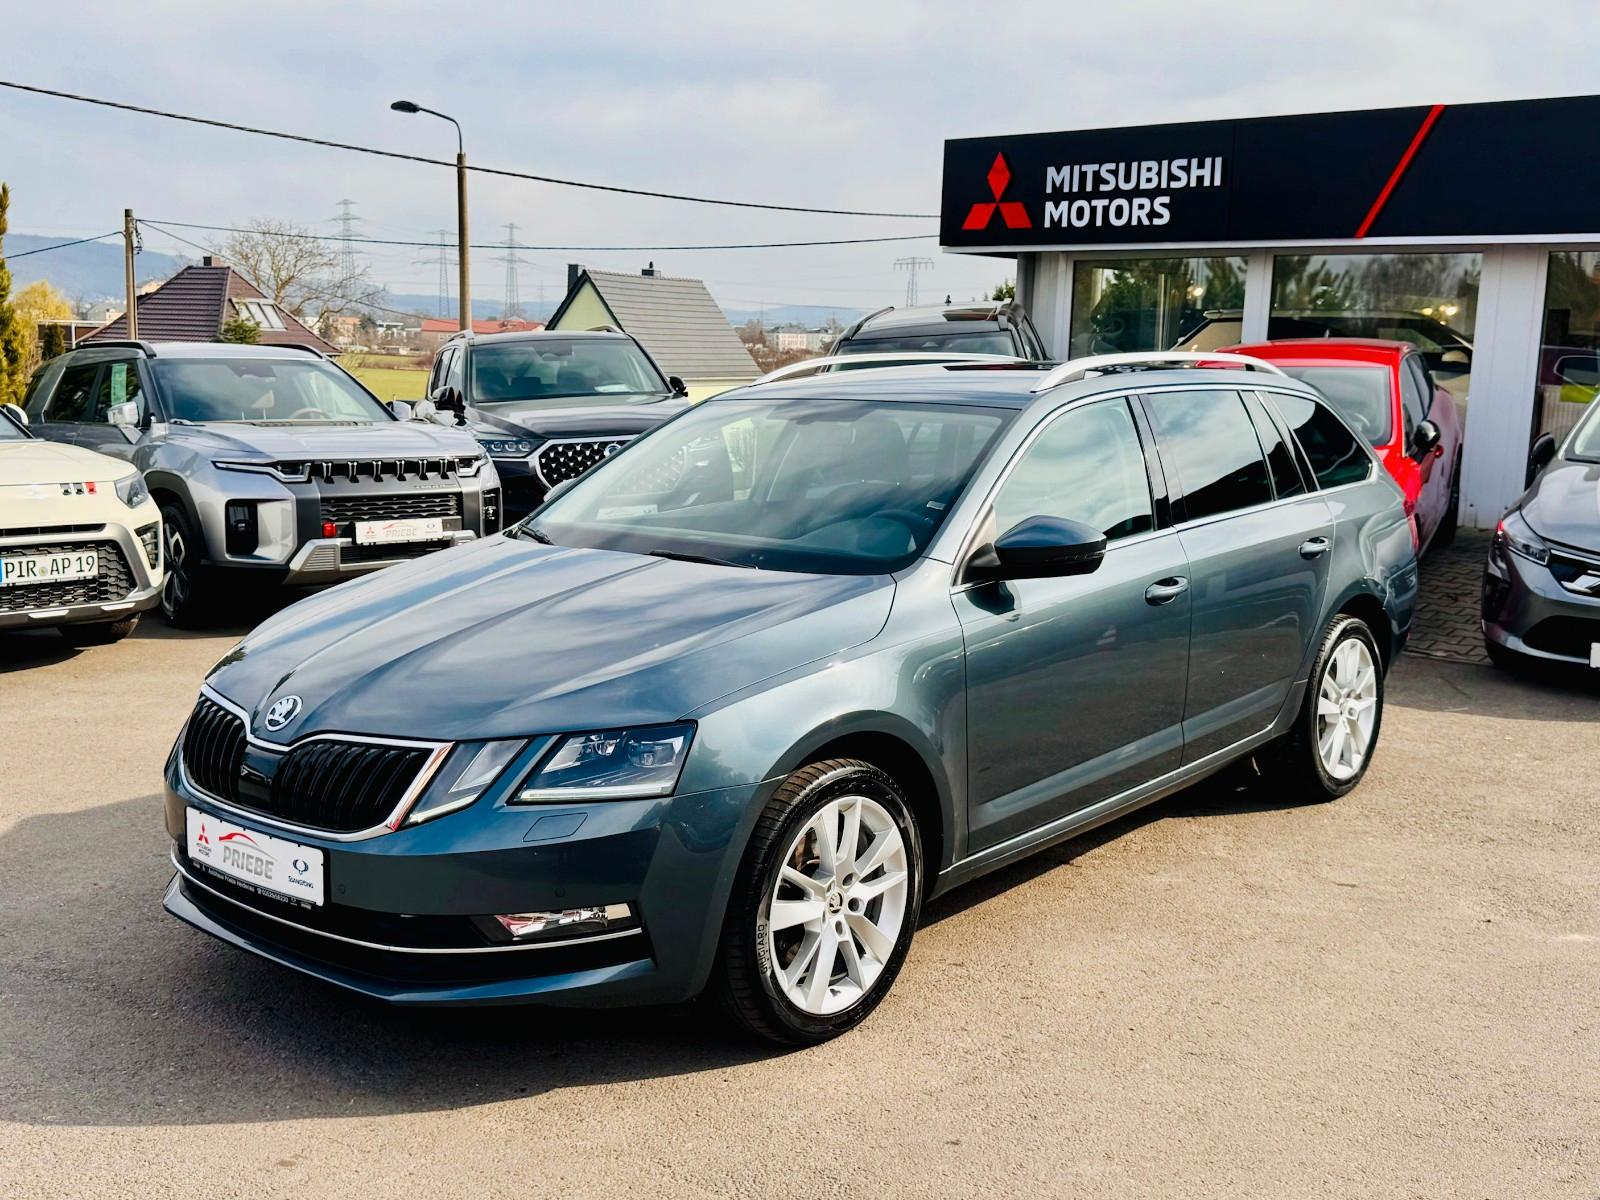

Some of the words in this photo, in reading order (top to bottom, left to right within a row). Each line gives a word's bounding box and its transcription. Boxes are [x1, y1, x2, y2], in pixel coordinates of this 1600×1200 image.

[1046, 156, 1222, 194] MITSUBISHI
[1044, 196, 1170, 228] MOTORS
[385, 527, 417, 538] PRIEBE
[4, 560, 37, 579] PIR
[50, 557, 71, 575] AP
[75, 555, 95, 573] 19
[222, 845, 275, 880] PRIEBE
[758, 924, 768, 975] GIUGIARO
